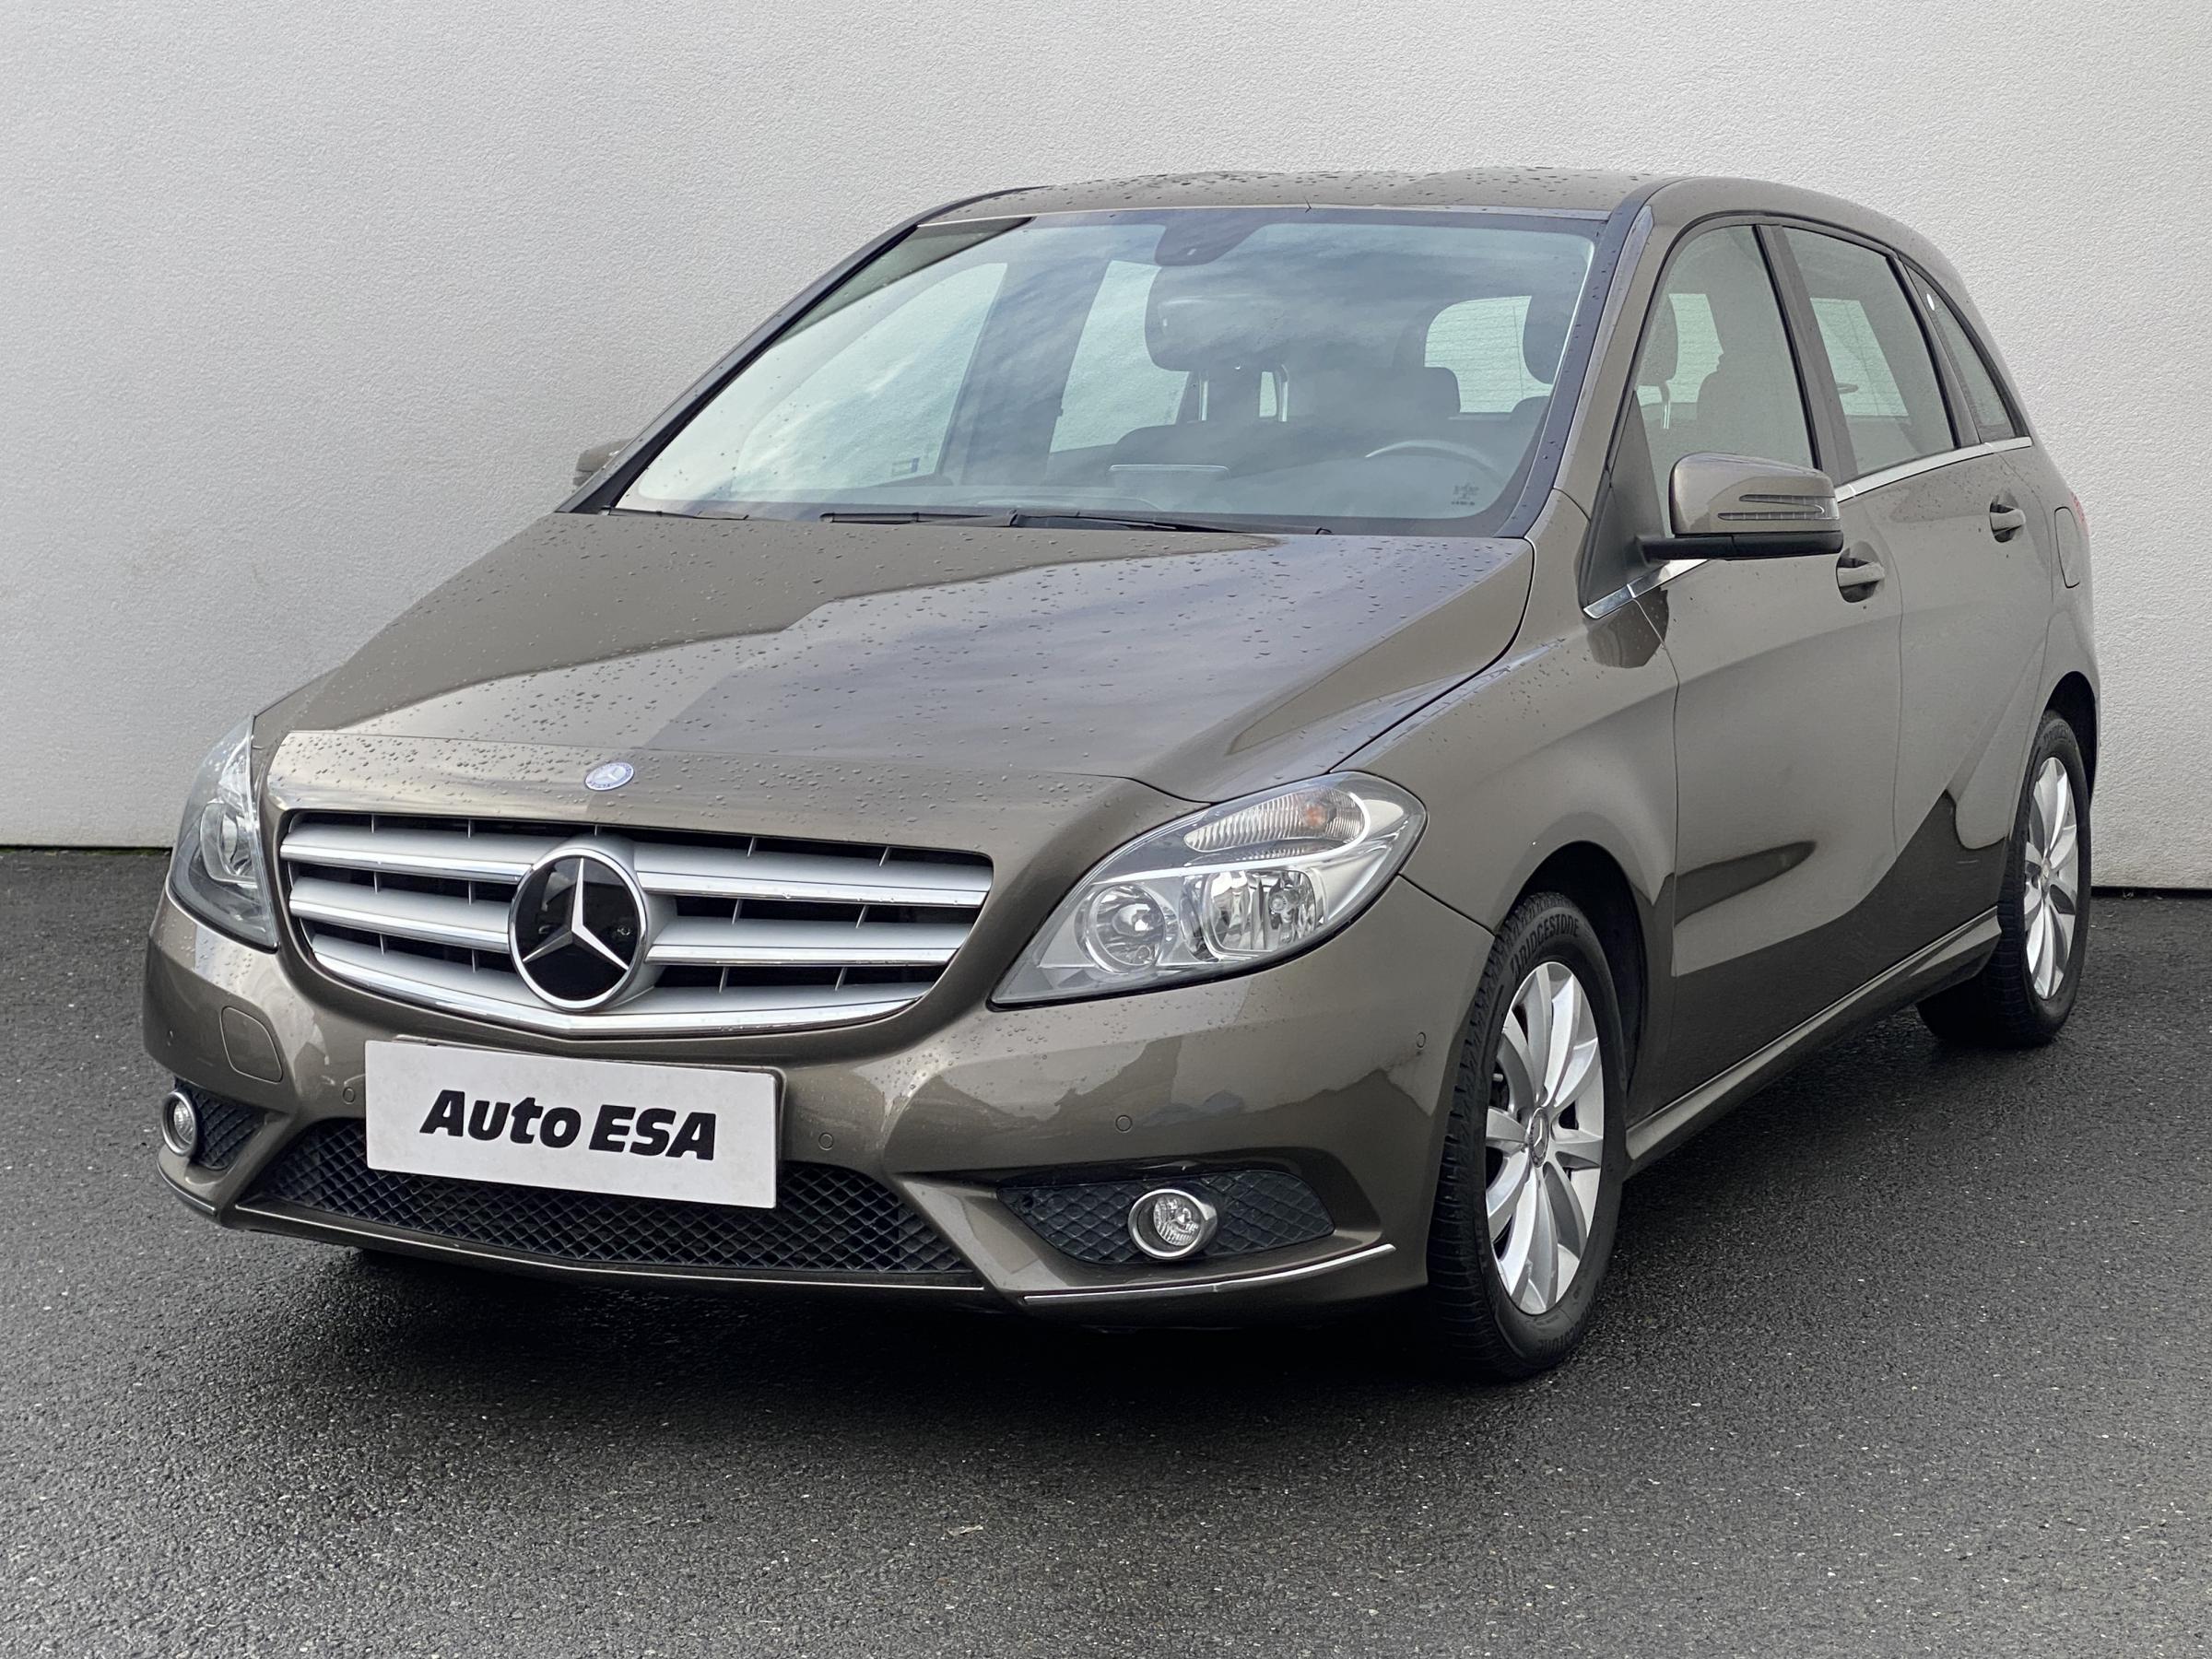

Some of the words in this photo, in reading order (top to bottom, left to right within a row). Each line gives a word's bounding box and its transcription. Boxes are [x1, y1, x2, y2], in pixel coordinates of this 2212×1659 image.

[1510, 913, 1580, 979] BRIDGESTONE
[419, 1089, 582, 1148] Auto
[588, 1104, 717, 1161] ESA
